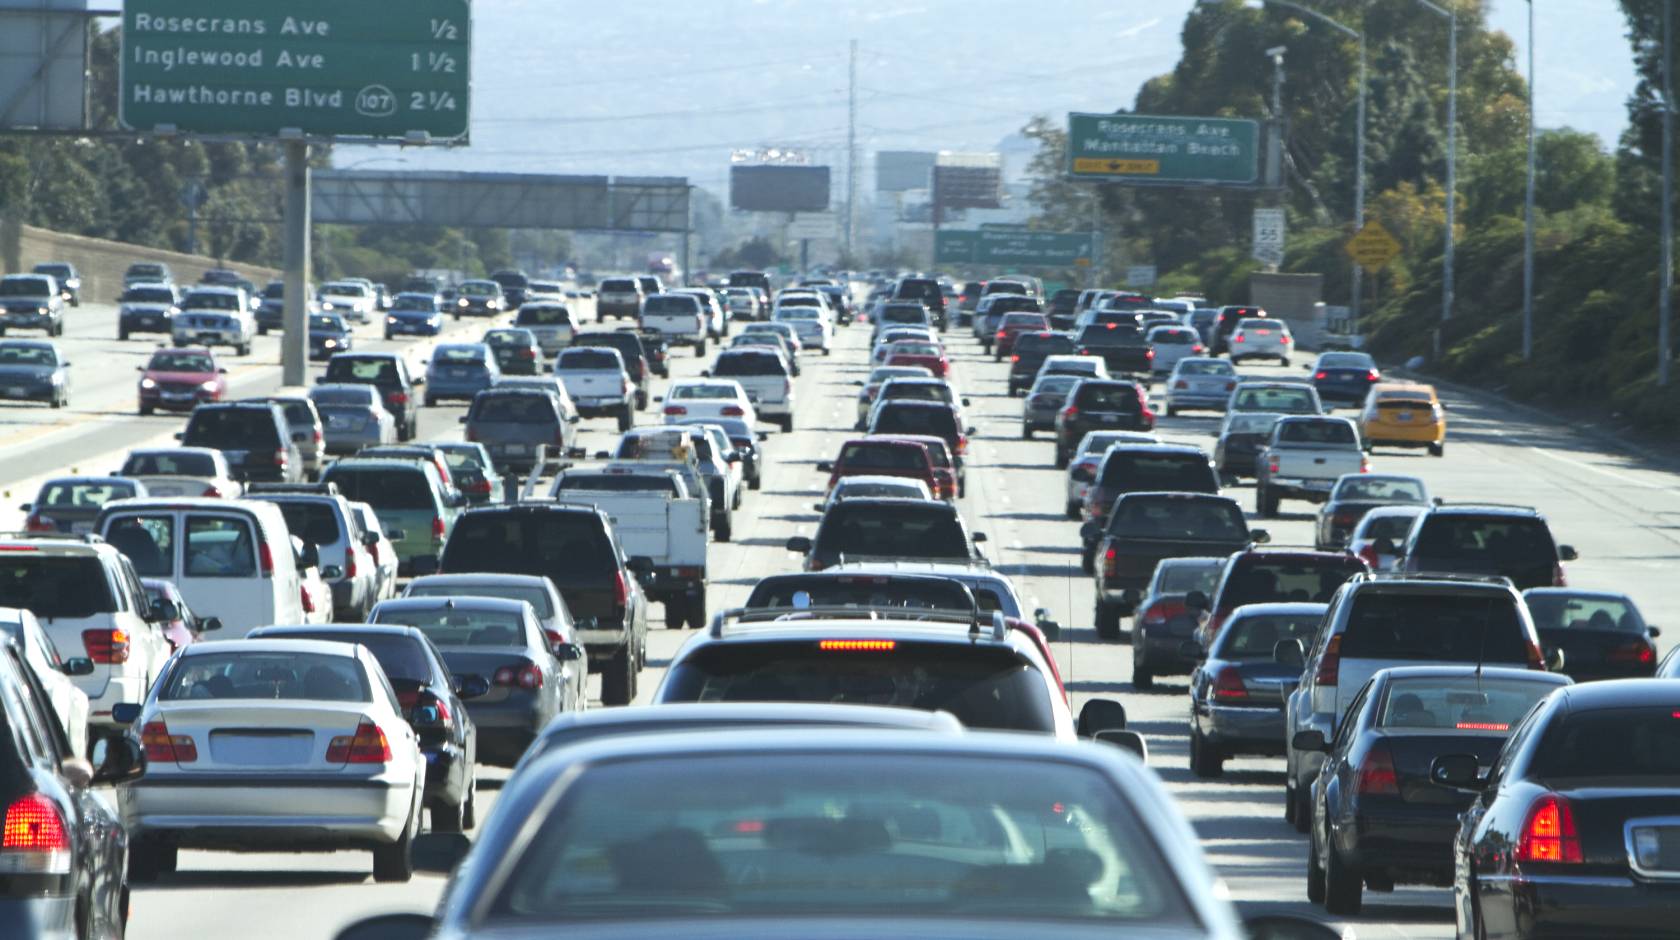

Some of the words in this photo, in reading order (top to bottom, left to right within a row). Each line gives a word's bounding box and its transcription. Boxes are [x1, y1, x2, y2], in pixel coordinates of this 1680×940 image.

[135, 13, 267, 34] Rosecrans
[280, 16, 329, 36] Ave
[134, 45, 263, 71] Inglewood
[276, 49, 325, 68] Ave
[133, 84, 273, 105] Hawthorne
[285, 88, 343, 107] Blvd
[361, 94, 389, 109] 107
[1260, 228, 1278, 241] 55
